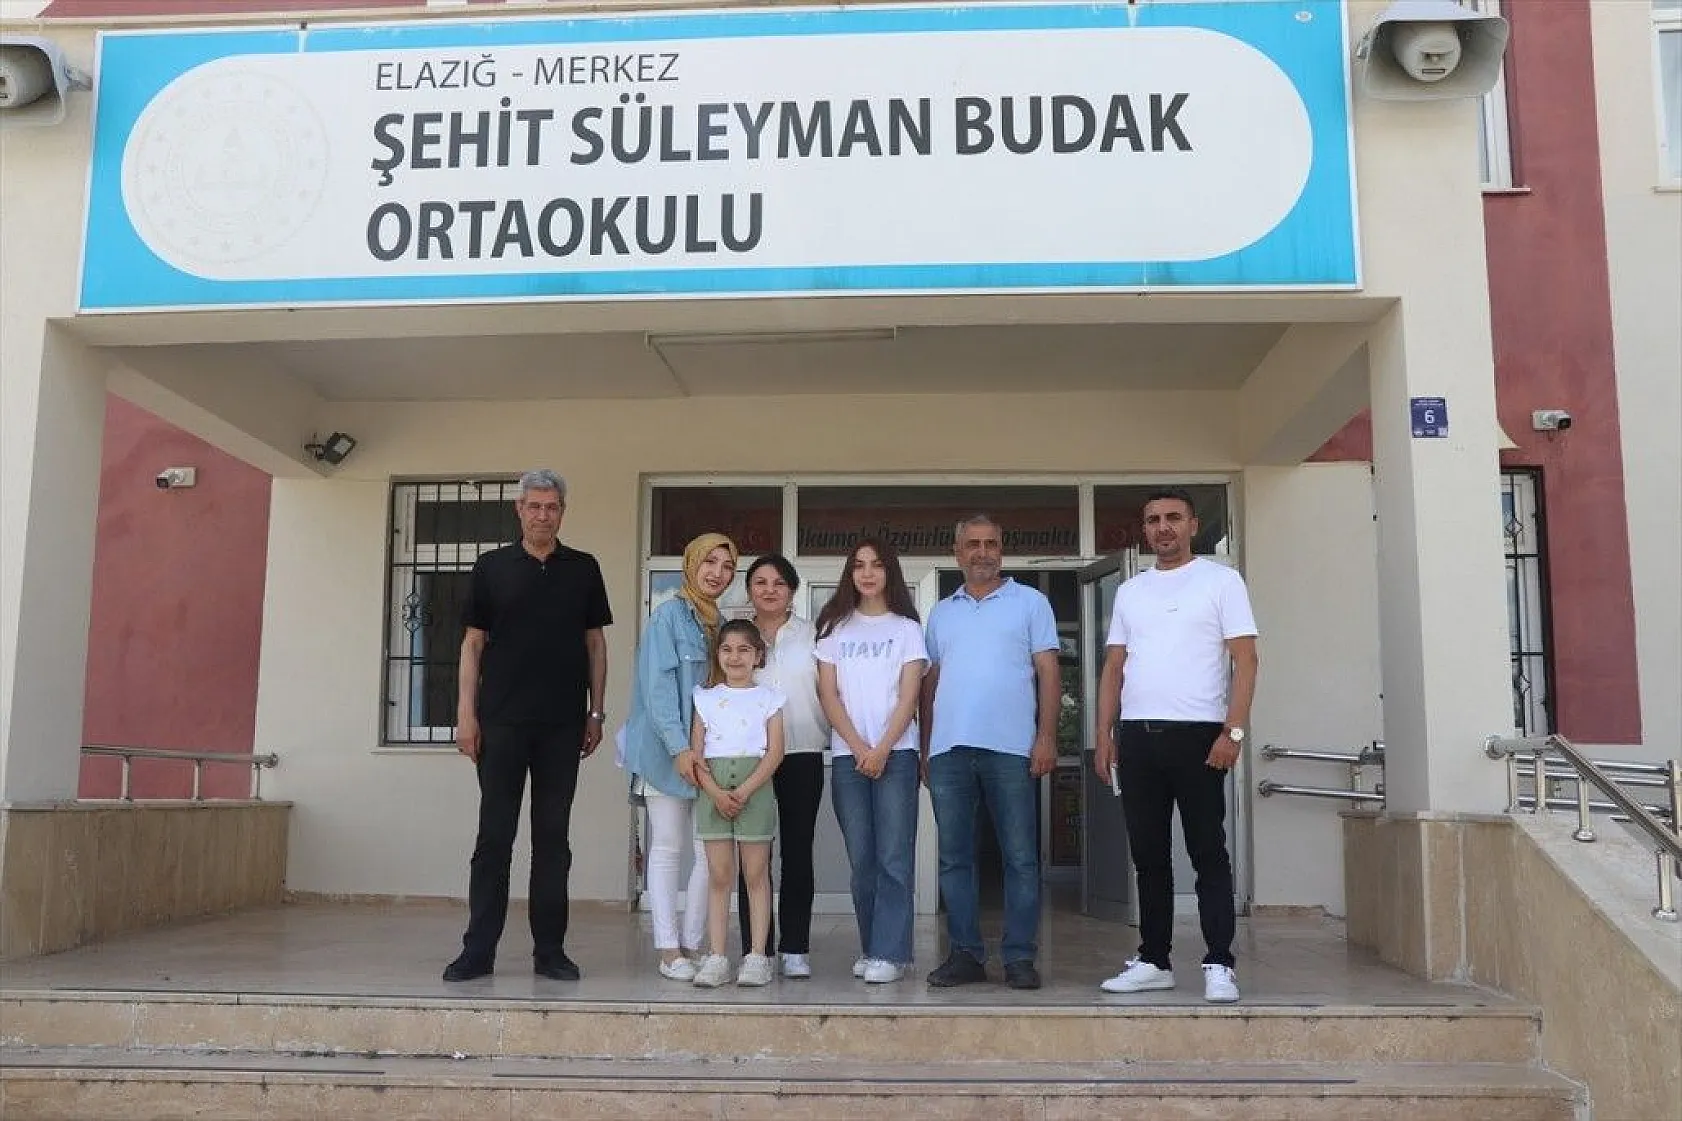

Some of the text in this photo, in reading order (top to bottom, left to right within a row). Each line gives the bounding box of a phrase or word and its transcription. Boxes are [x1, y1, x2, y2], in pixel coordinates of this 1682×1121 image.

[376, 53, 496, 91] ELAZIĞ
[534, 53, 679, 86] MERKEZ
[370, 92, 1195, 187] ŞEHİT SÜLEYMAN BUDAK
[367, 192, 763, 262] ORTAOKULU
[1424, 409, 1435, 424] 6
